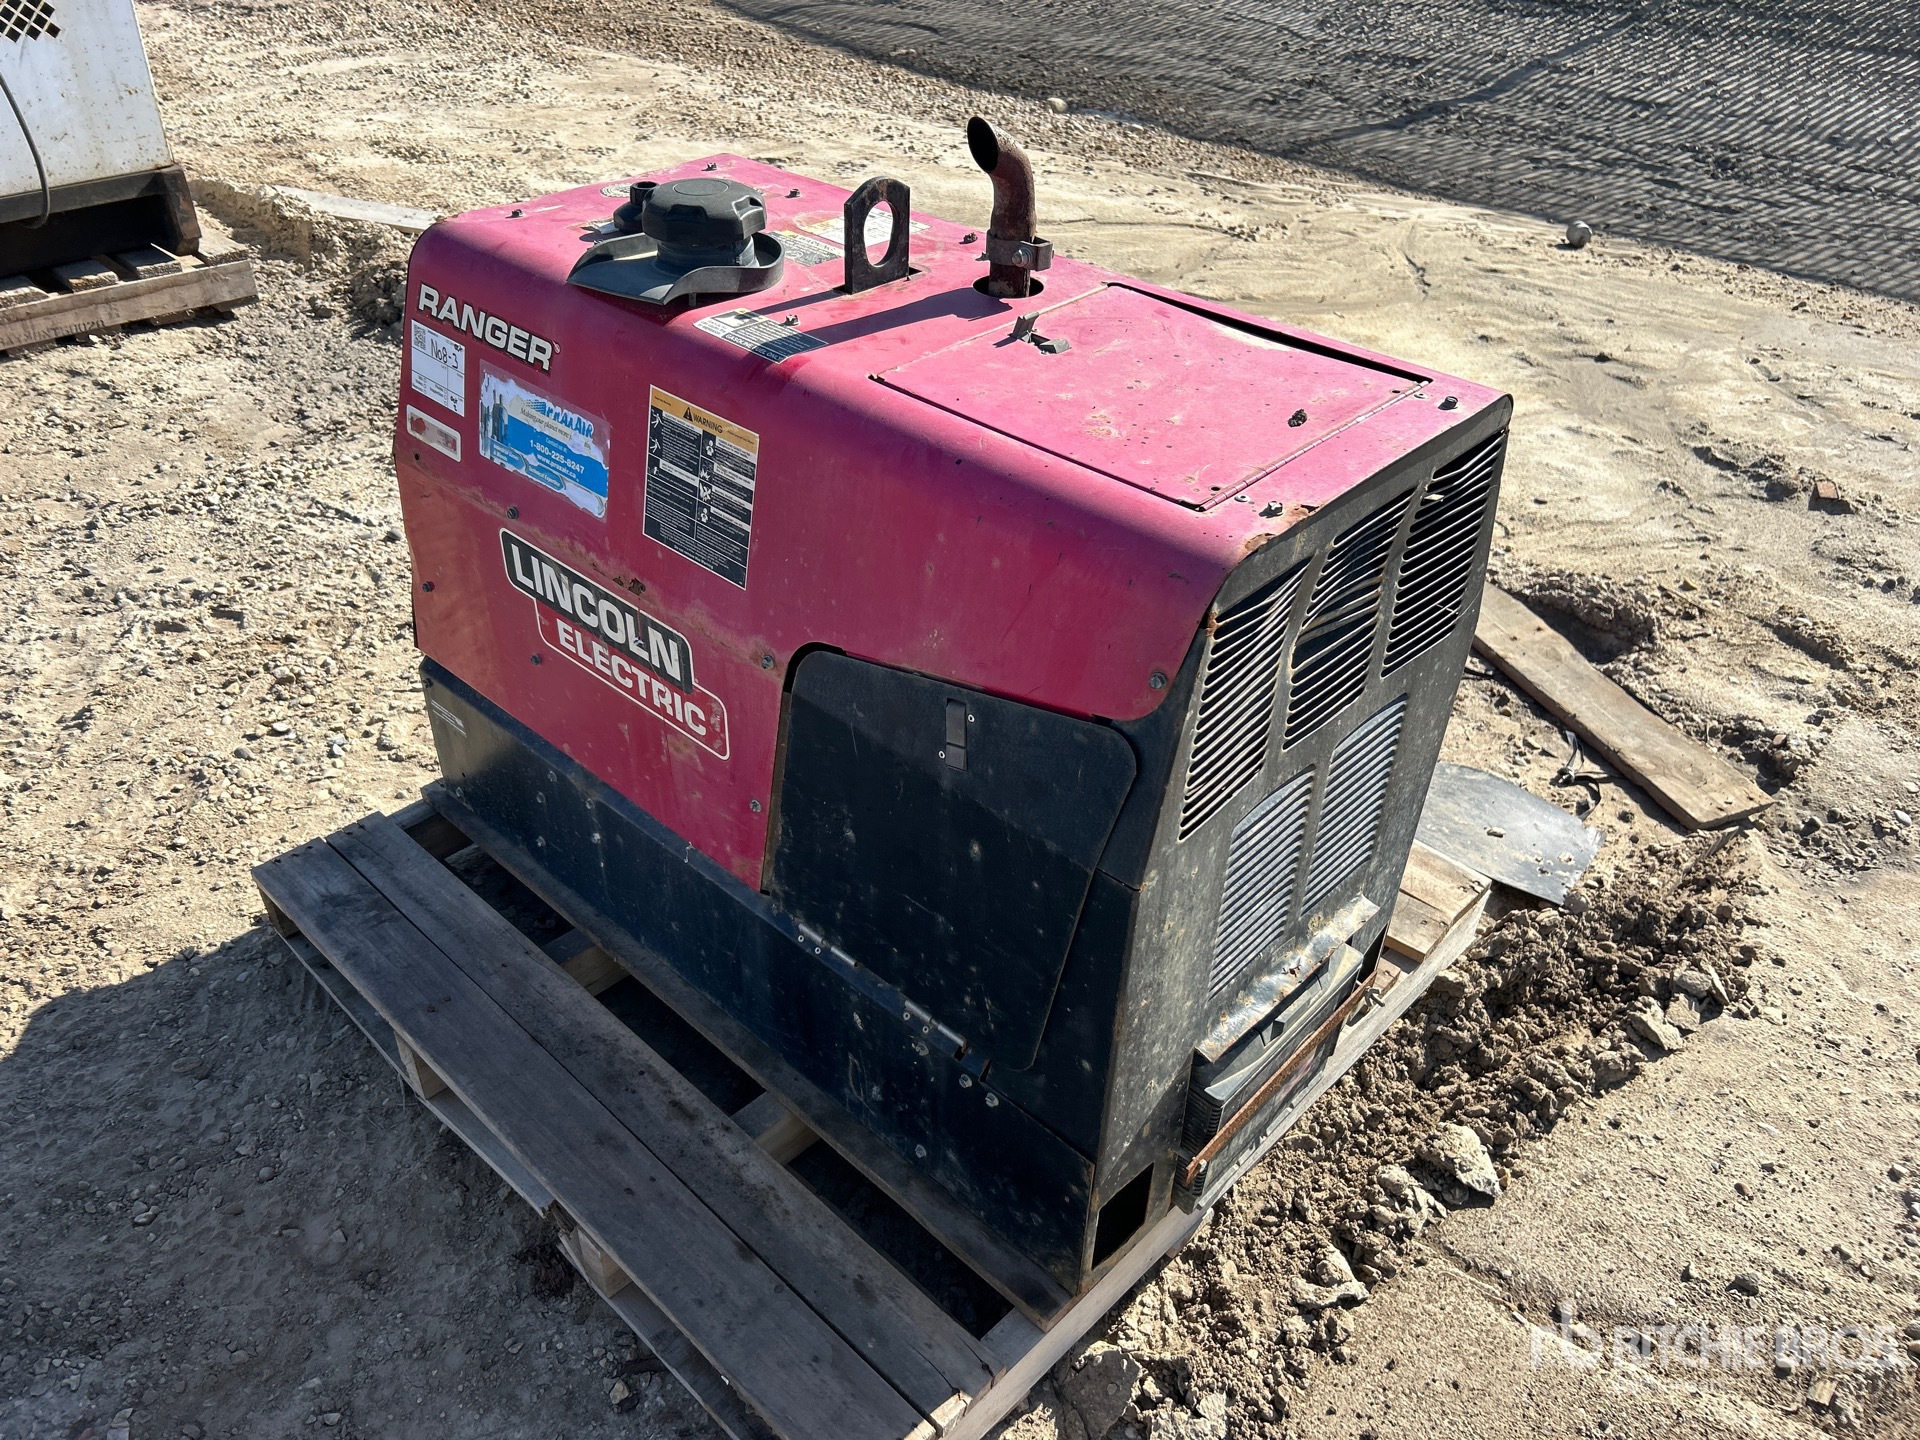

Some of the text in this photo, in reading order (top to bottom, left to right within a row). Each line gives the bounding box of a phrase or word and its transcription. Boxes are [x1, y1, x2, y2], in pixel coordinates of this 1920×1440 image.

[418, 283, 553, 372] RANGER
[725, 333, 753, 349] GASOLINE
[693, 412, 723, 434] WARNING
[529, 439, 584, 475] 1-800-225-8247
[511, 543, 681, 682] LINCOLN
[556, 618, 707, 737] ELECTRIC
